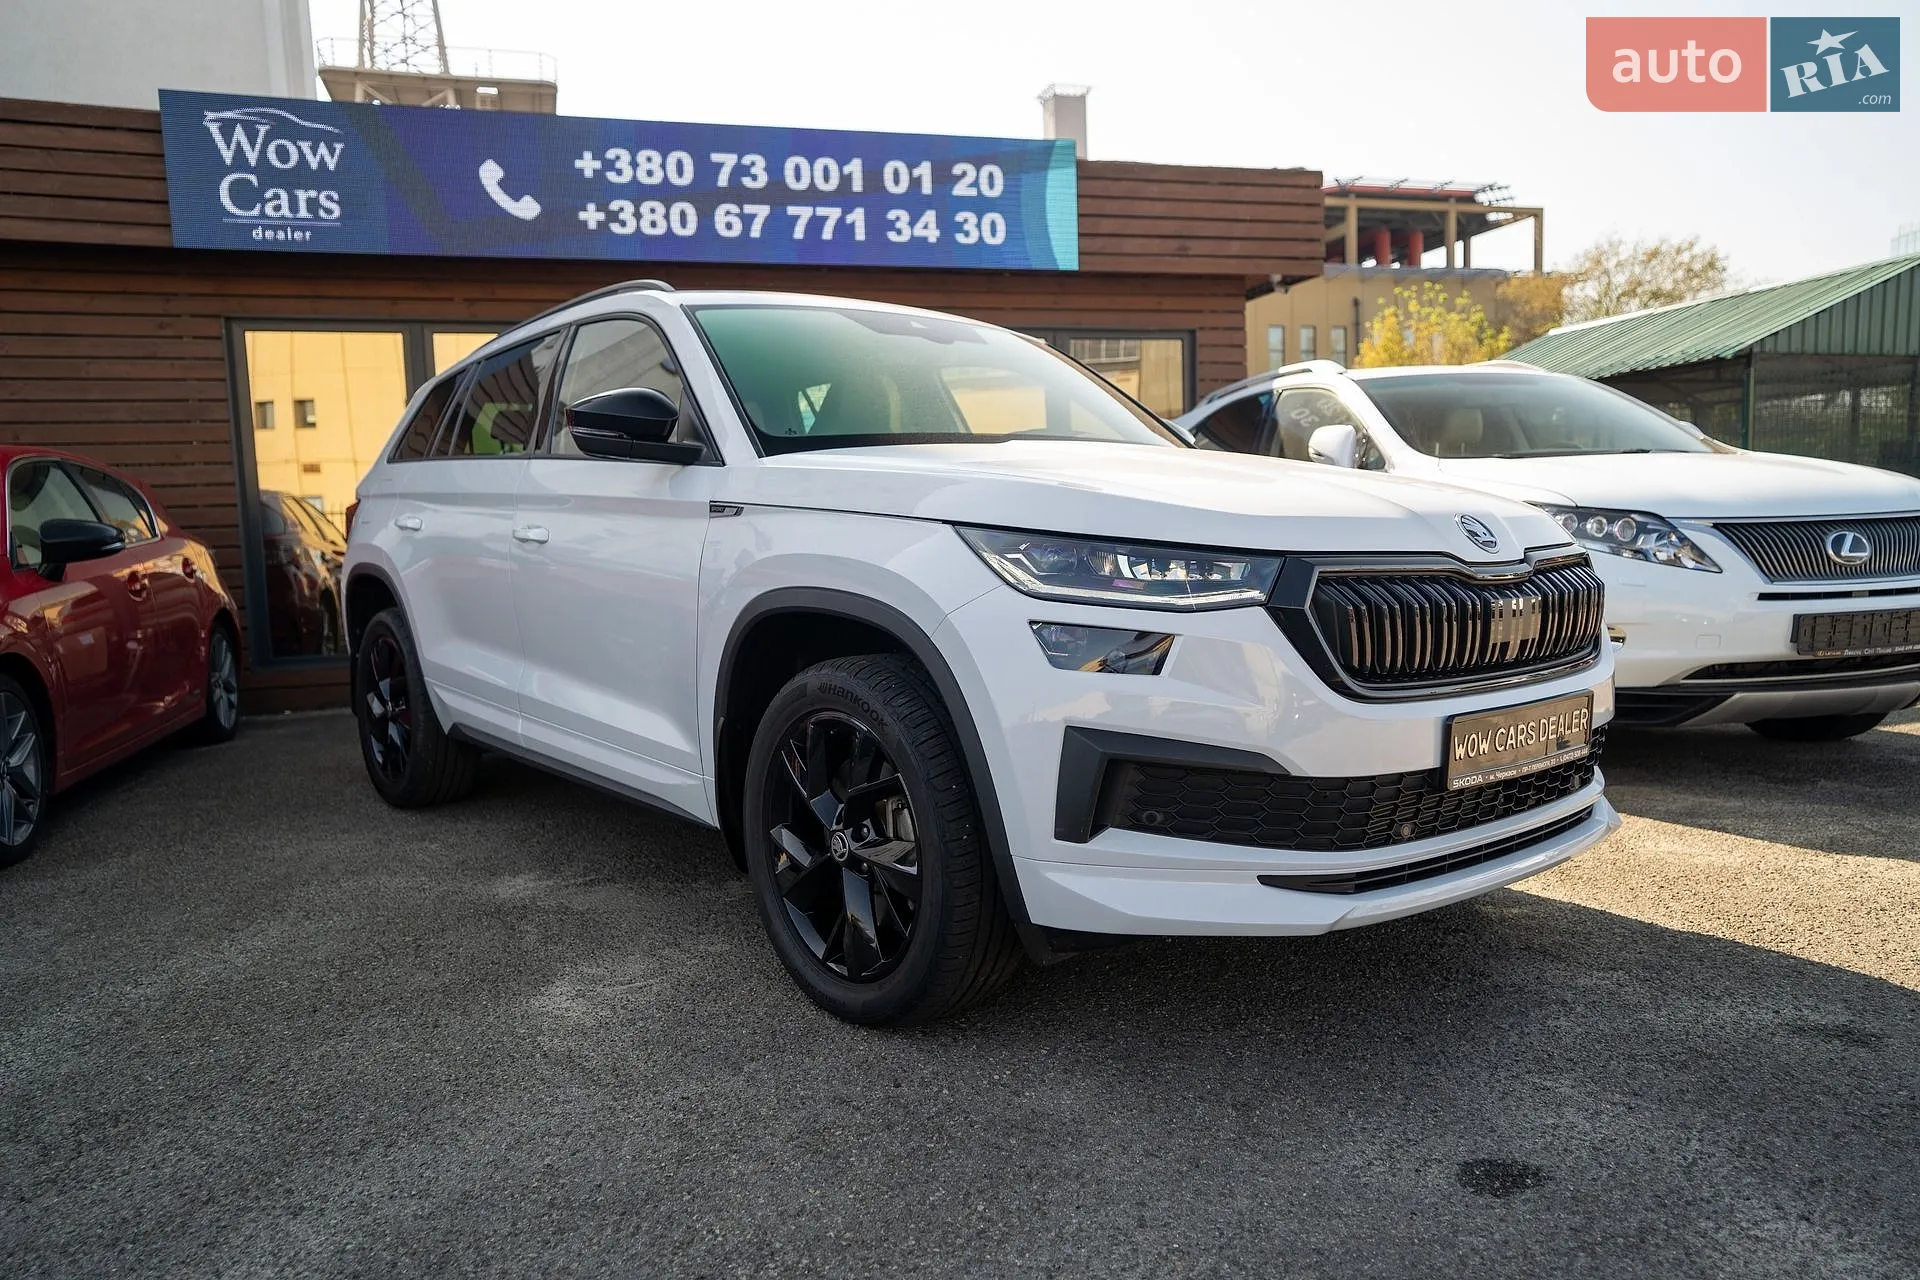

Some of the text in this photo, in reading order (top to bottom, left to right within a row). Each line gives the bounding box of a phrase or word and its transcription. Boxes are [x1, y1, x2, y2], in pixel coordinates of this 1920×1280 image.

[209, 122, 345, 171] Wow
[218, 173, 342, 220] Cars
[575, 148, 1005, 198] +380 73 001 01 20
[251, 225, 312, 242] dealer
[578, 200, 1007, 245] +380 67 771 34 30
[1454, 708, 1589, 761] WOW CARS DEALER
